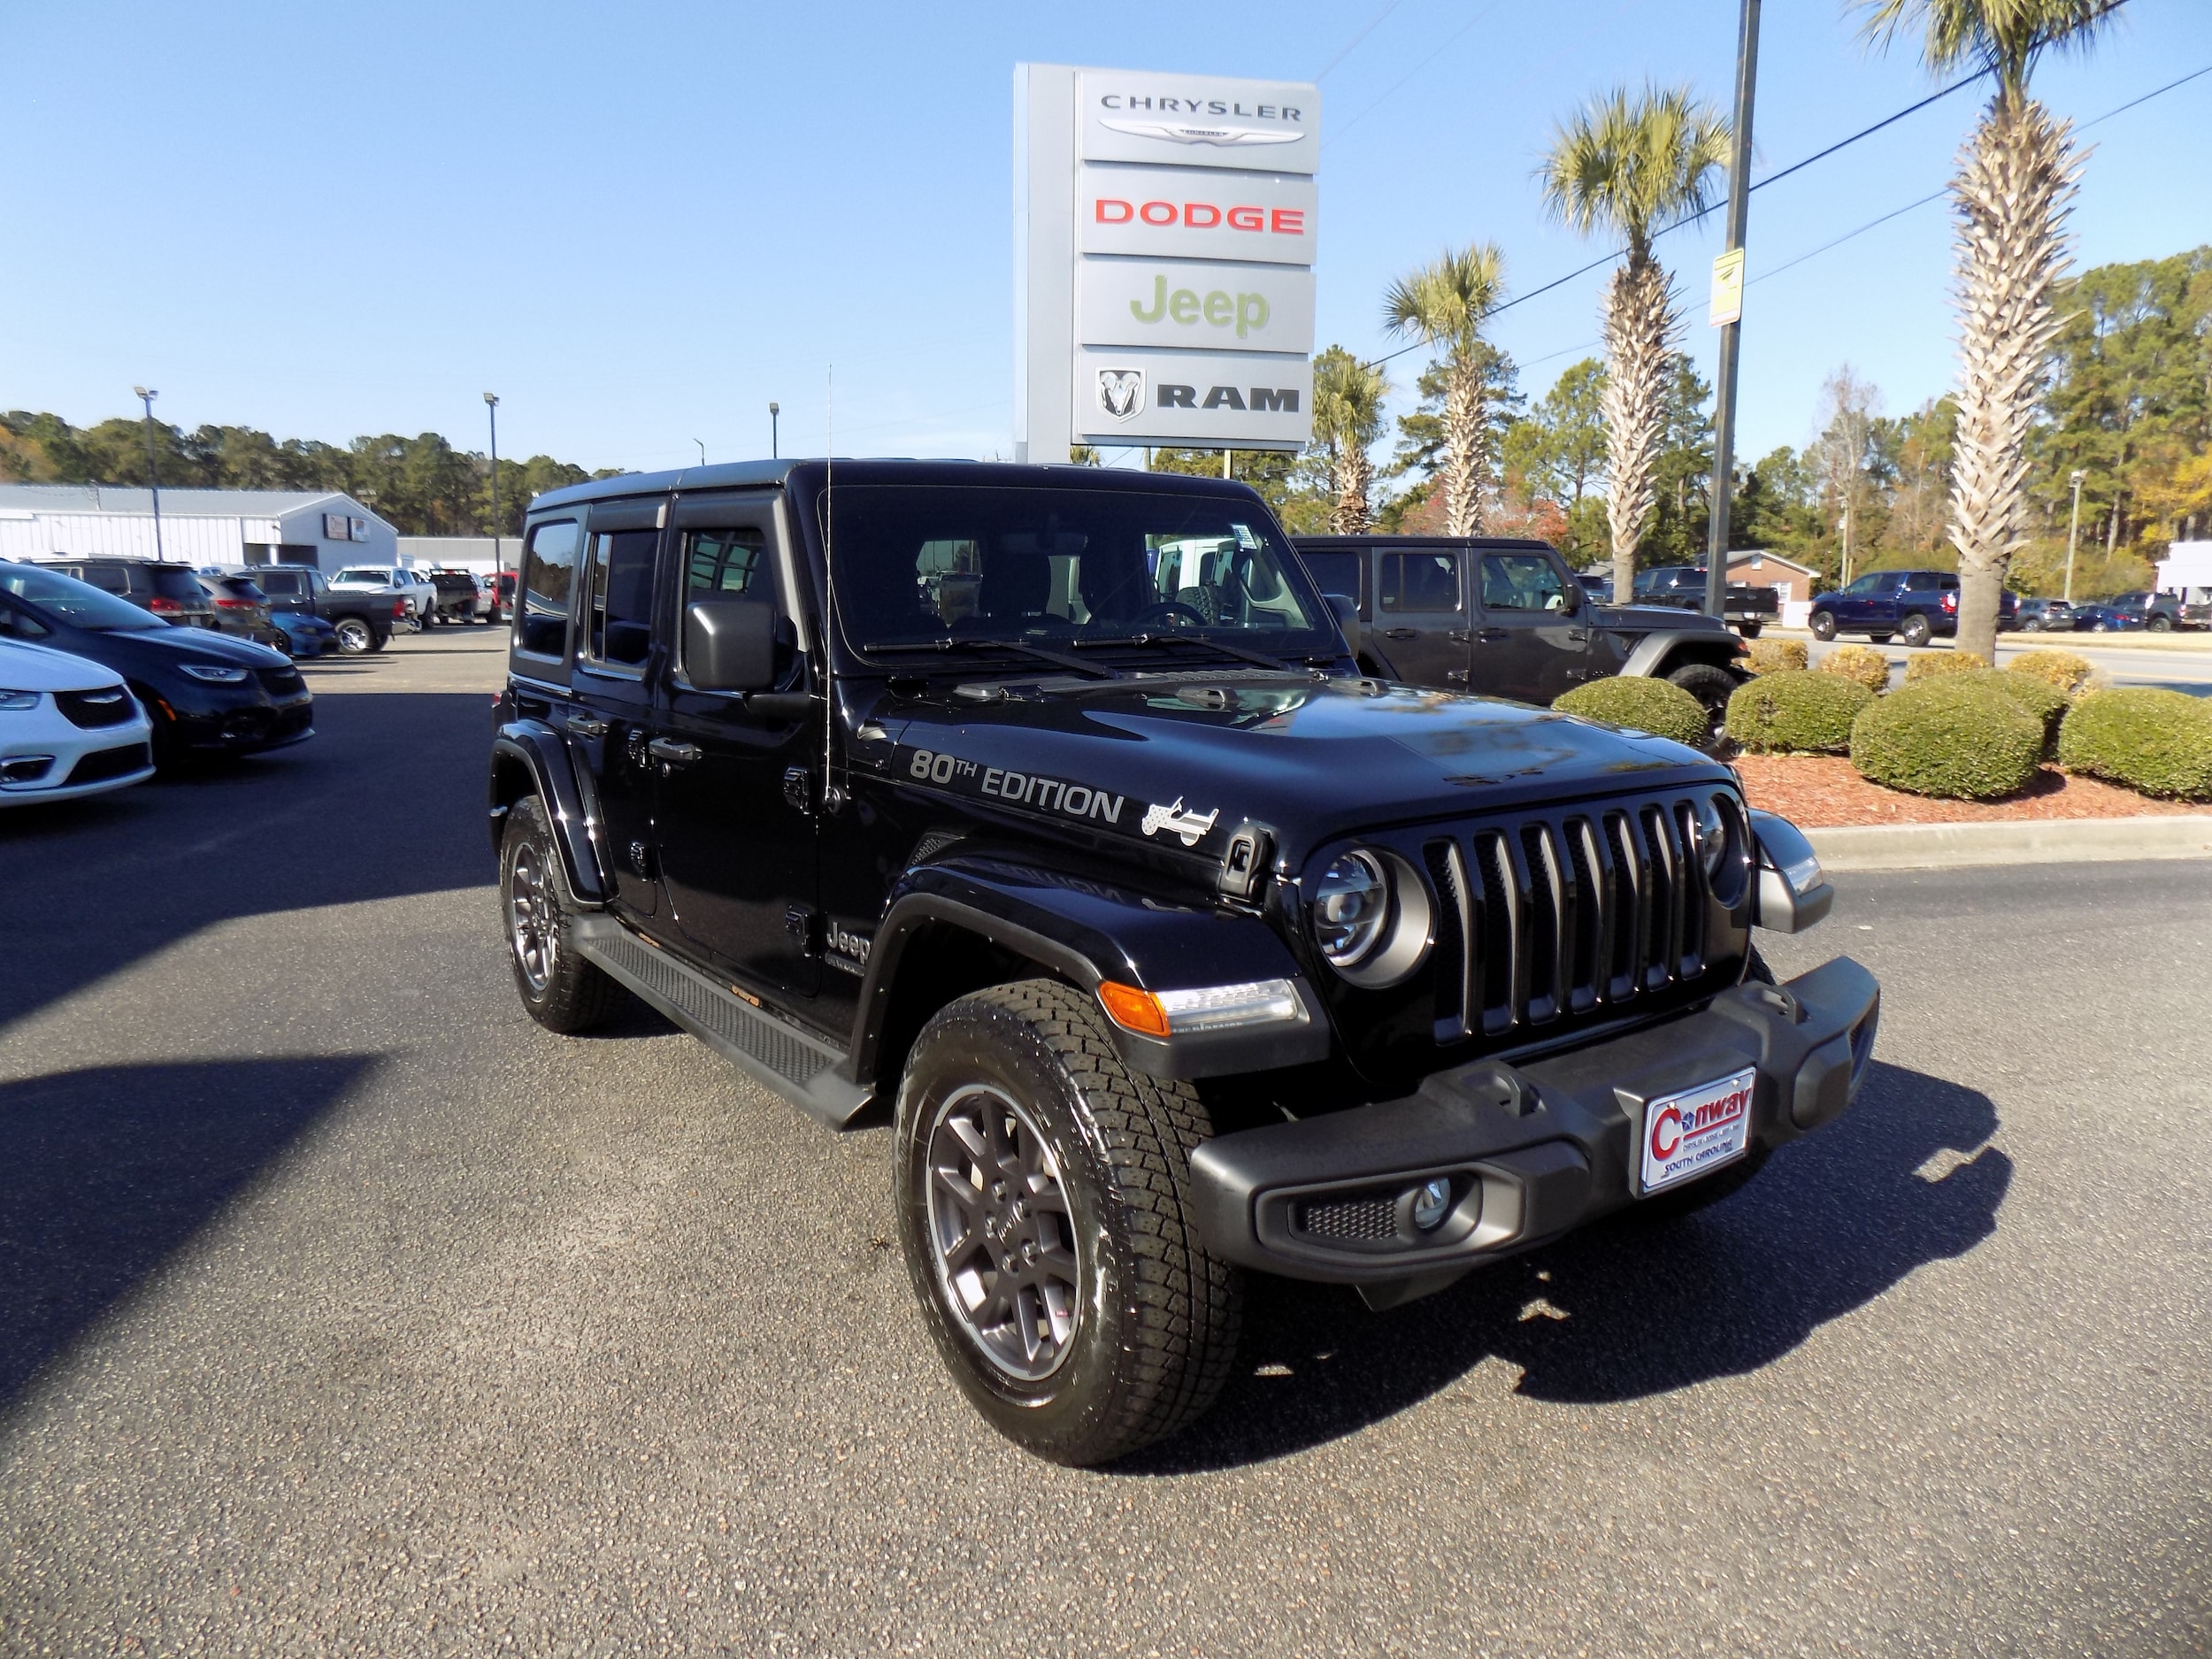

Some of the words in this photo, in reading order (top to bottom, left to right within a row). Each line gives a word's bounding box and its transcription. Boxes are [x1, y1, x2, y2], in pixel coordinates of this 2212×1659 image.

[1101, 95, 1302, 122] CHRYSLER
[1095, 199, 1304, 235] DODGE
[1130, 274, 1270, 339] Jeep
[1157, 384, 1300, 413] RAM
[980, 767, 1125, 825] EDITION
[826, 921, 871, 964] Jeep
[1664, 1156, 1694, 1173] SOUTH
[1695, 1138, 1732, 1161] CAROLINA
